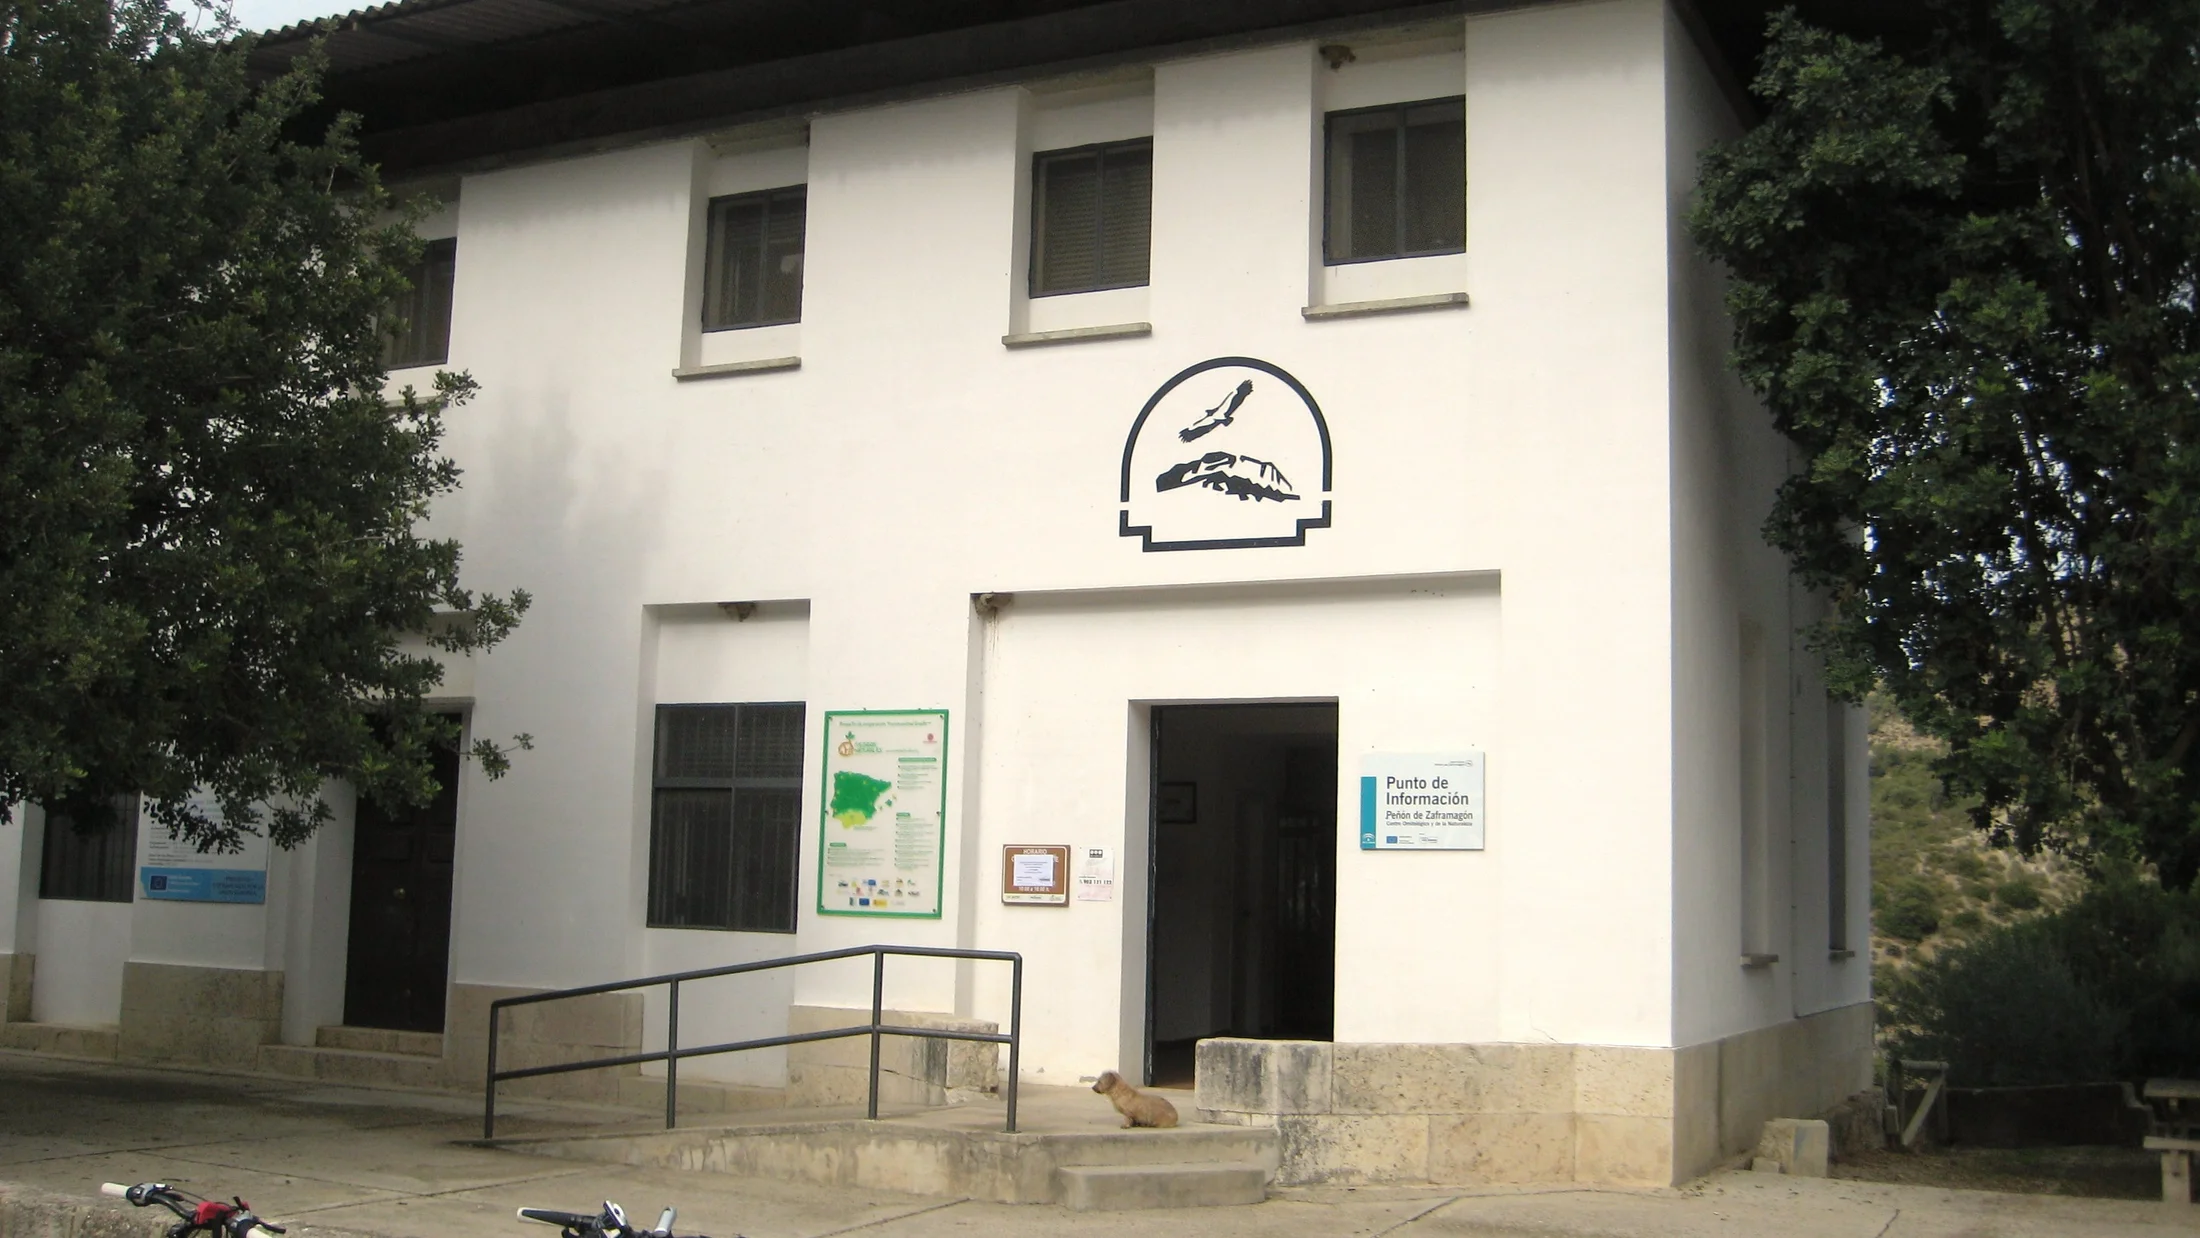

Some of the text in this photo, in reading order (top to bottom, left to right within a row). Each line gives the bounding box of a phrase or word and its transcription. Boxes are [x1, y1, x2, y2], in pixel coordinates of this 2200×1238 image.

[1386, 776, 1449, 790] Punto de
[1386, 791, 1469, 805] Información
[1385, 810, 1473, 822] Peñón de Zaframagón
